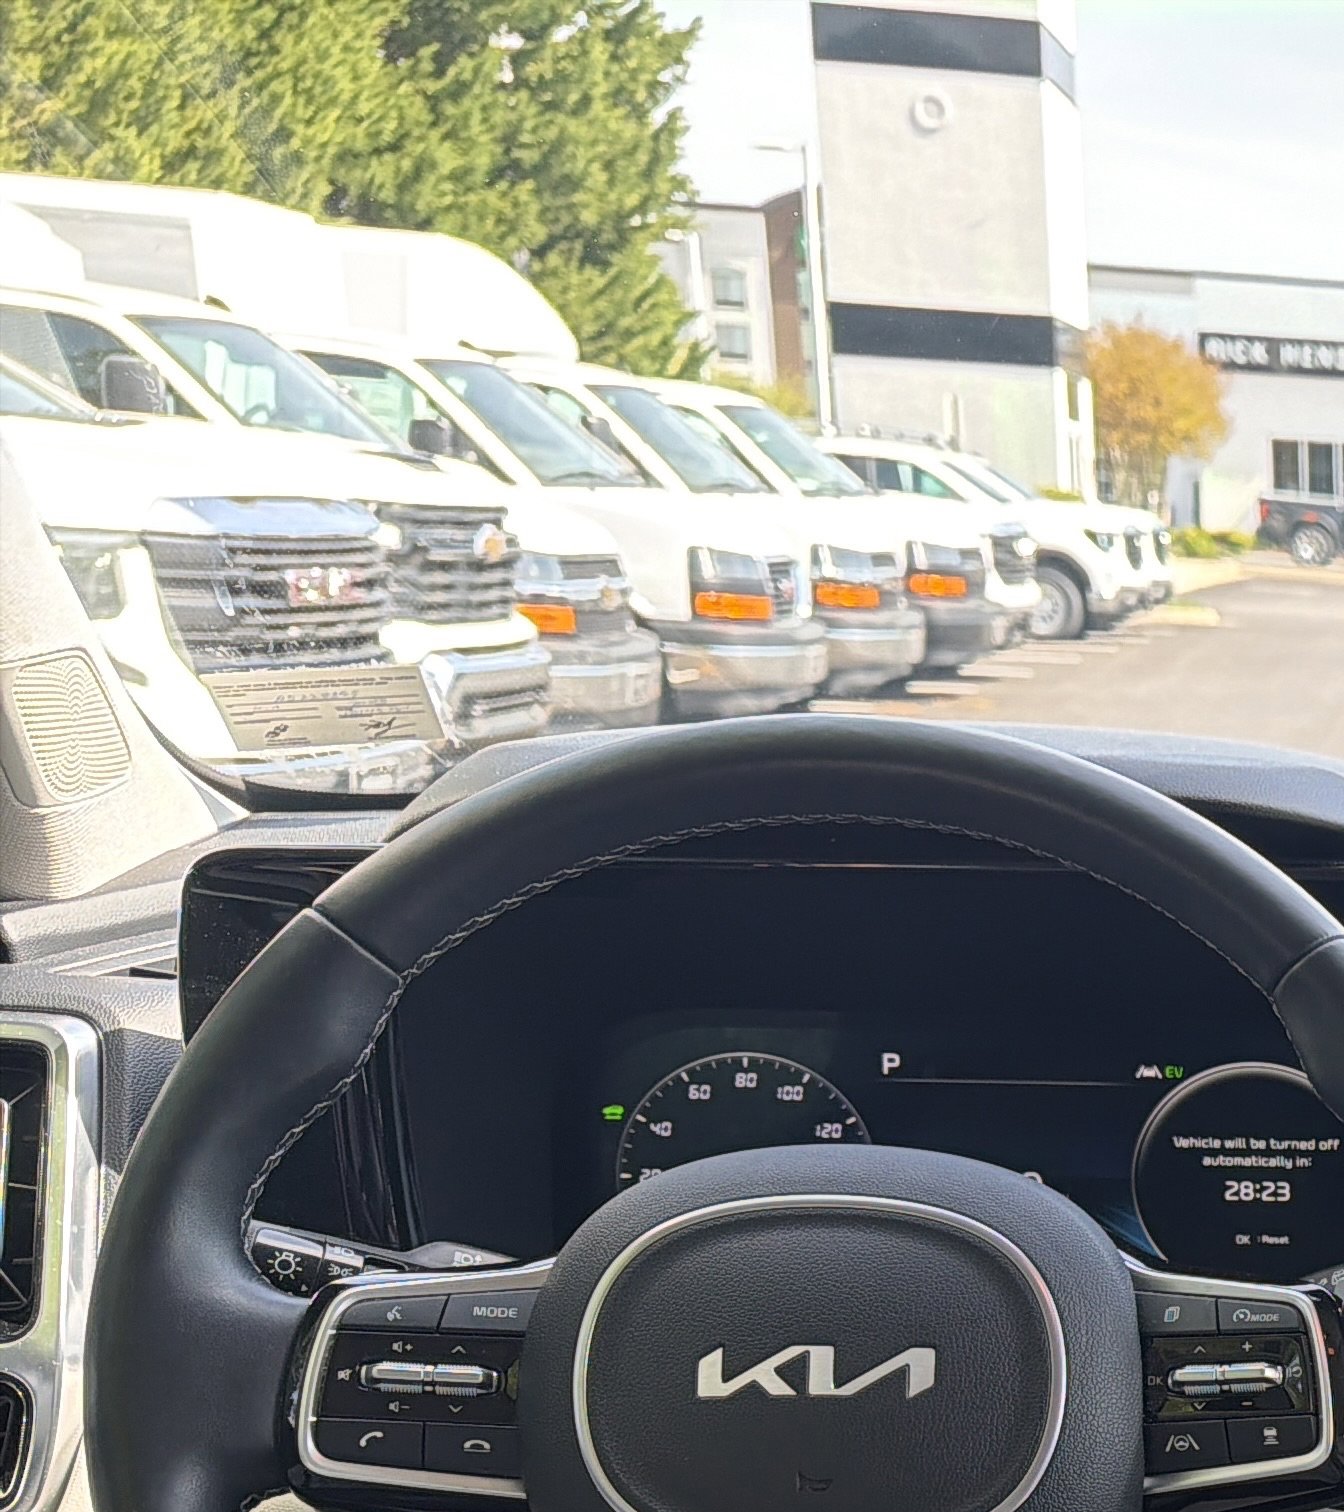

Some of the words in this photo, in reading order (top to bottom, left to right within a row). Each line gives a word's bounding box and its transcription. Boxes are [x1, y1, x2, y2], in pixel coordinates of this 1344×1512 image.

[1203, 336, 1268, 366] RICK
[882, 1053, 900, 1074] P
[1165, 1066, 1184, 1079] EV
[735, 1073, 757, 1088] 80
[688, 1085, 711, 1100] 60
[776, 1086, 803, 1101] 100
[649, 1122, 672, 1137] 40
[815, 1124, 842, 1139] 120
[1172, 1136, 1221, 1149] Vehicle
[1224, 1137, 1247, 1149] will
[1250, 1138, 1267, 1150] be
[1269, 1138, 1316, 1150] turned
[1318, 1138, 1341, 1151] off
[1202, 1155, 1293, 1169] automatically
[1295, 1156, 1313, 1168] in:
[1224, 1180, 1291, 1202] 28:23
[1235, 1234, 1251, 1245] OK
[1262, 1234, 1290, 1245] Reset
[473, 1306, 518, 1319] MODE
[1250, 1313, 1280, 1322] MODE
[698, 1345, 936, 1400] KIA
